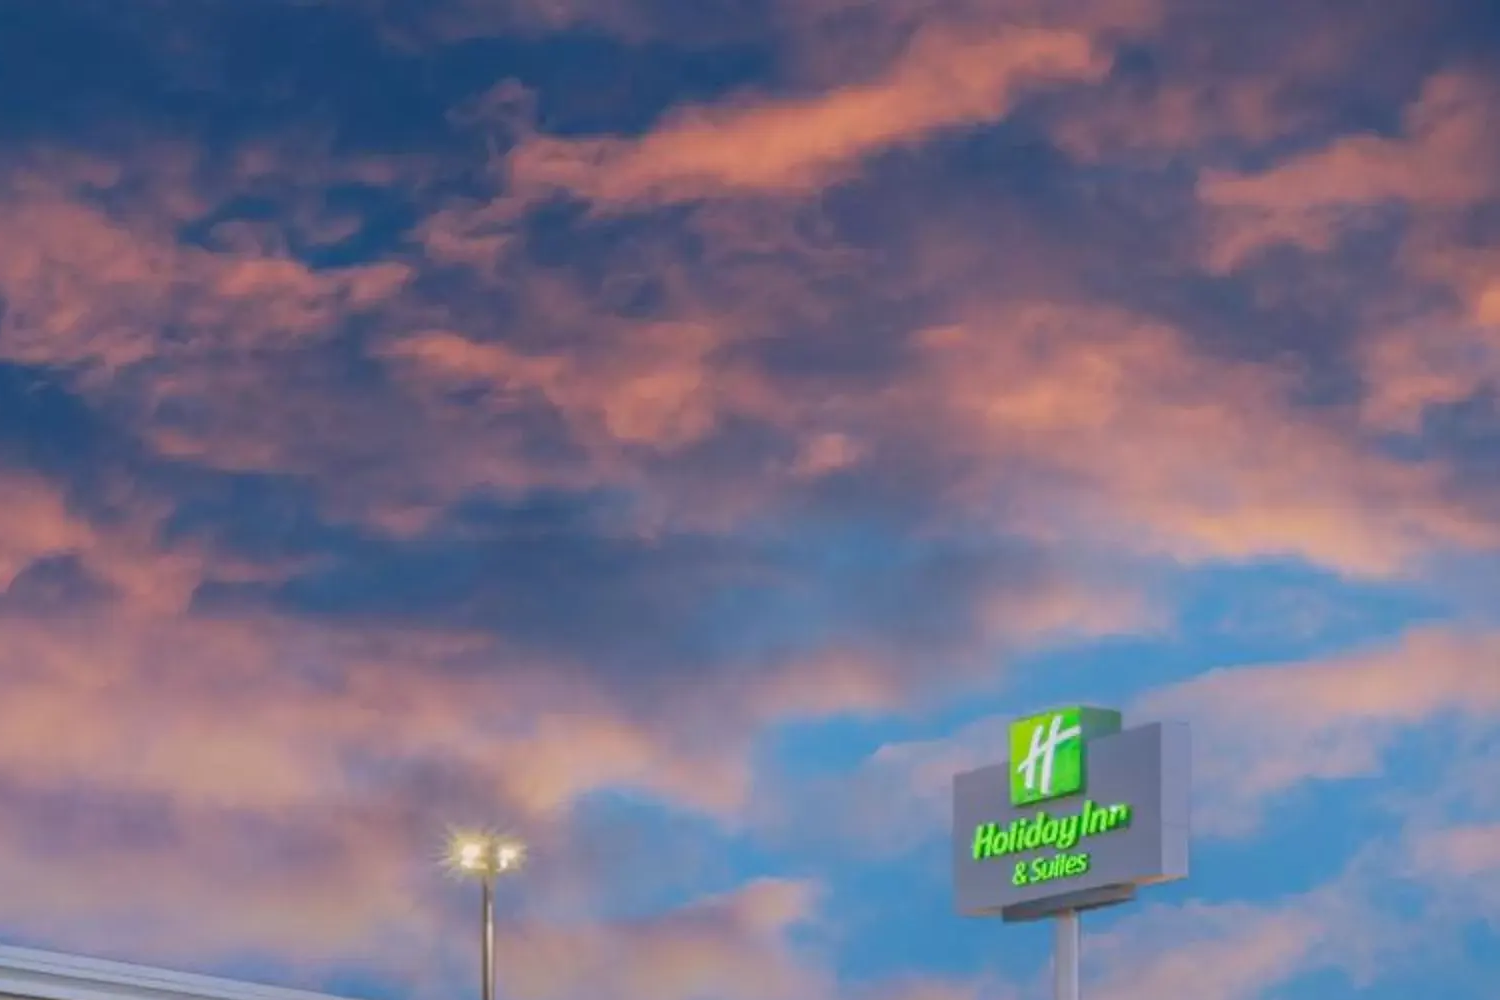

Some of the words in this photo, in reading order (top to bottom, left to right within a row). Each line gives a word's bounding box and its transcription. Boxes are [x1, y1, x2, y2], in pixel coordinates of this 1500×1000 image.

[973, 812, 1079, 860] Holiday
[1081, 800, 1129, 837] Inn
[1012, 861, 1028, 885] &
[1030, 853, 1088, 882] Suites
